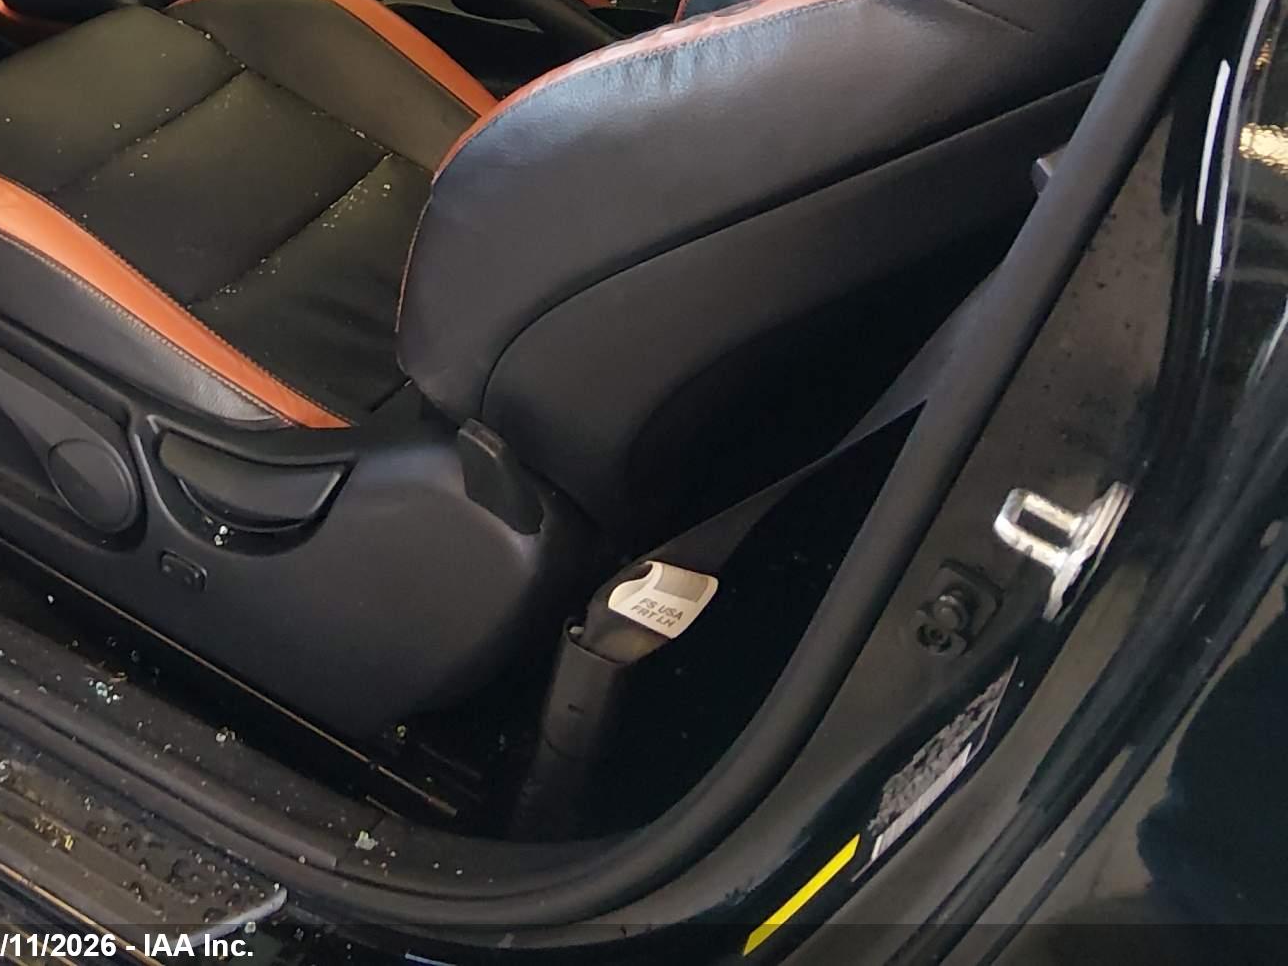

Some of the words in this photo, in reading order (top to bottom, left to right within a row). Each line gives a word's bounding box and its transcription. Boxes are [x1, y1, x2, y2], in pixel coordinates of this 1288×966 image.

[631, 605, 656, 619] FRT
[656, 615, 676, 628] LH
[658, 603, 684, 621] USA
